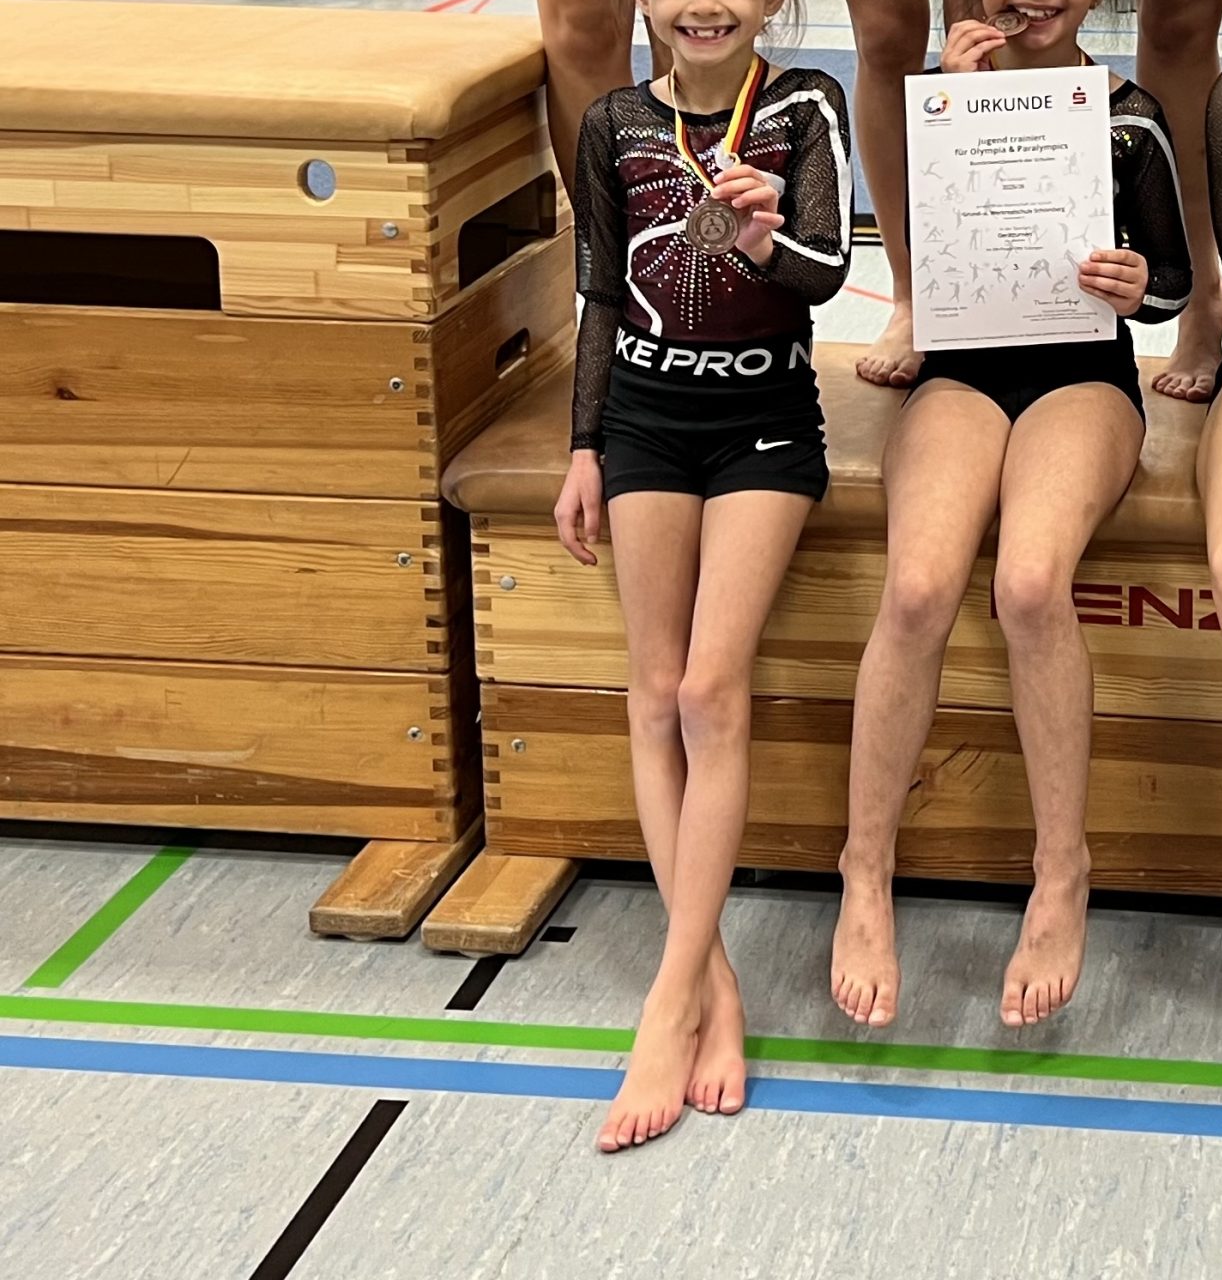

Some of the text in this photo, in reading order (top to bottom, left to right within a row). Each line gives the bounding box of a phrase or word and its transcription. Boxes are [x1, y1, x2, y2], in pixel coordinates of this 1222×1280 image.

[967, 95, 1053, 114] URKUNDE
[954, 143, 1069, 156] für Olympia & Paralympics
[660, 347, 773, 378] PRO
